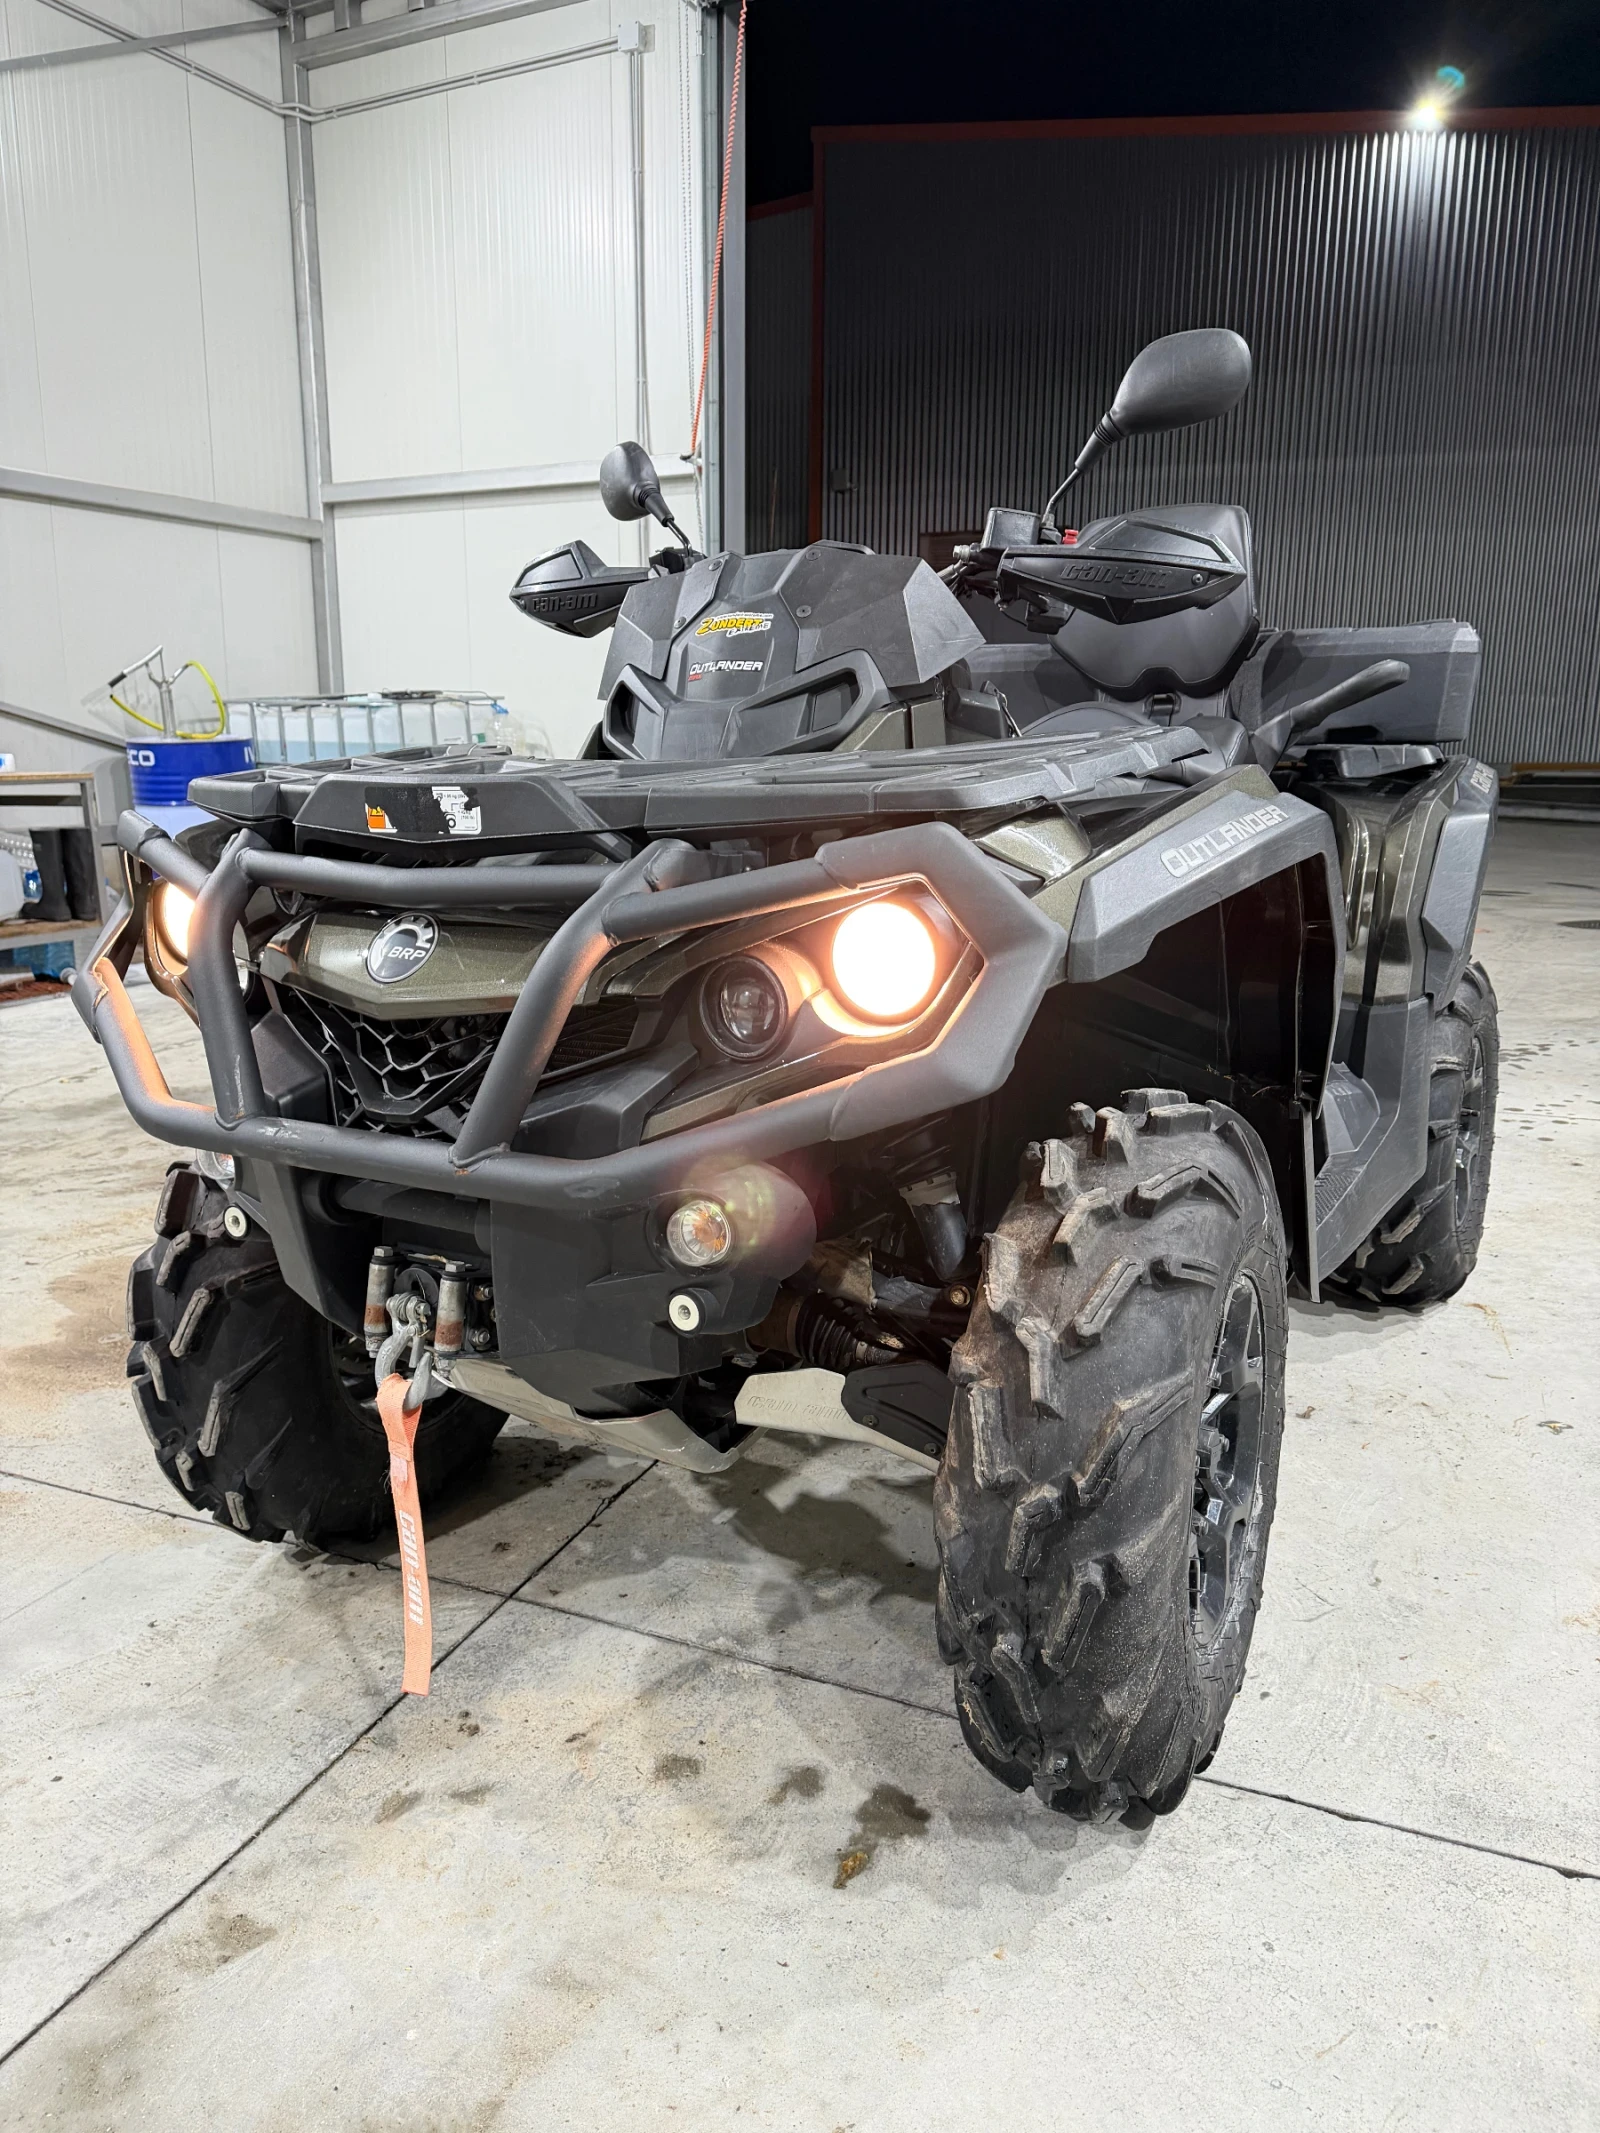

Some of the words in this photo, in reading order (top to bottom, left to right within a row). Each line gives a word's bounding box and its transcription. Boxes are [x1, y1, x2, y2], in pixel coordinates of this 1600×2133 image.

[1060, 563, 1172, 588] can-am
[531, 592, 598, 612] can-am
[697, 617, 763, 634] ZUNDERT
[690, 661, 763, 675] OUTLANDER
[1161, 805, 1289, 877] OUTLANDER
[388, 946, 427, 960] BRP
[399, 1510, 424, 1626] can-am
